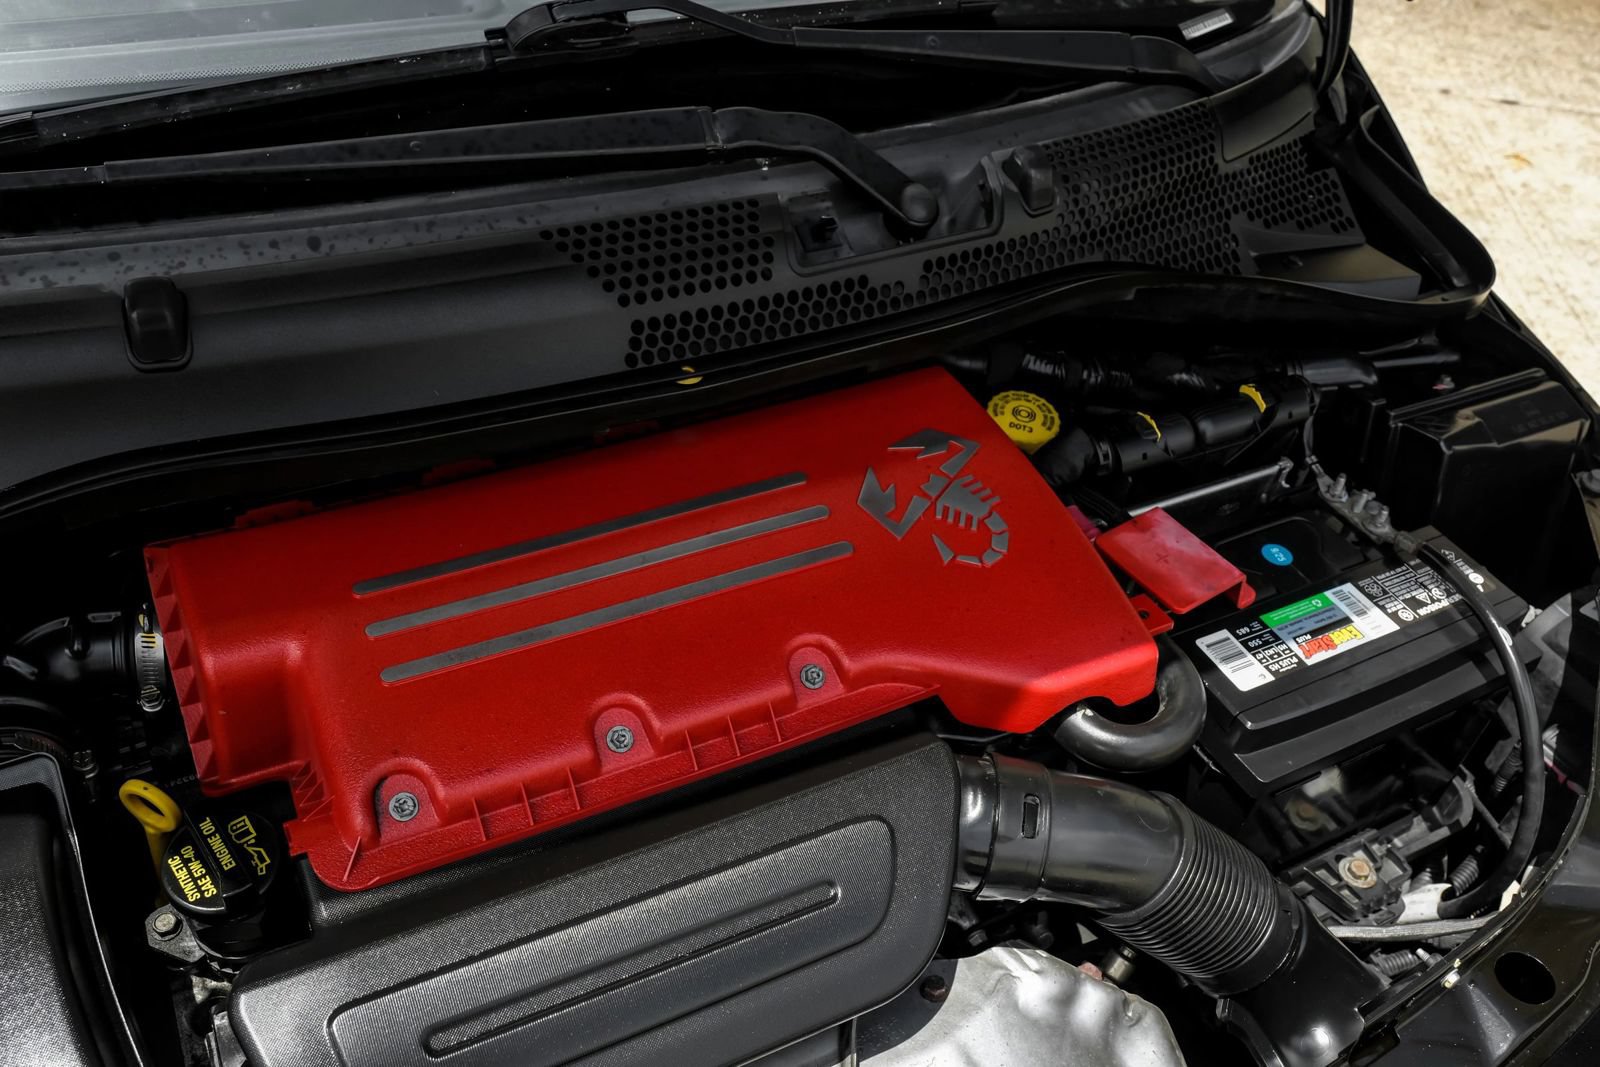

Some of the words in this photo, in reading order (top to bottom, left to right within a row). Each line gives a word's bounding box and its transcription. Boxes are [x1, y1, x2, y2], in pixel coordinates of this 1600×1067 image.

[1008, 421, 1034, 433] DOT3
[1236, 626, 1250, 636] 685
[1295, 633, 1312, 644] PLUS
[1298, 623, 1365, 659] EverStart
[1247, 638, 1263, 648] 550
[1279, 655, 1299, 668] PLUS
[199, 816, 216, 836] OIL
[180, 845, 206, 878] 5W-40
[207, 833, 237, 871] ENGINE
[167, 855, 201, 902] SYNTHETIC
[197, 875, 217, 898] SAE
